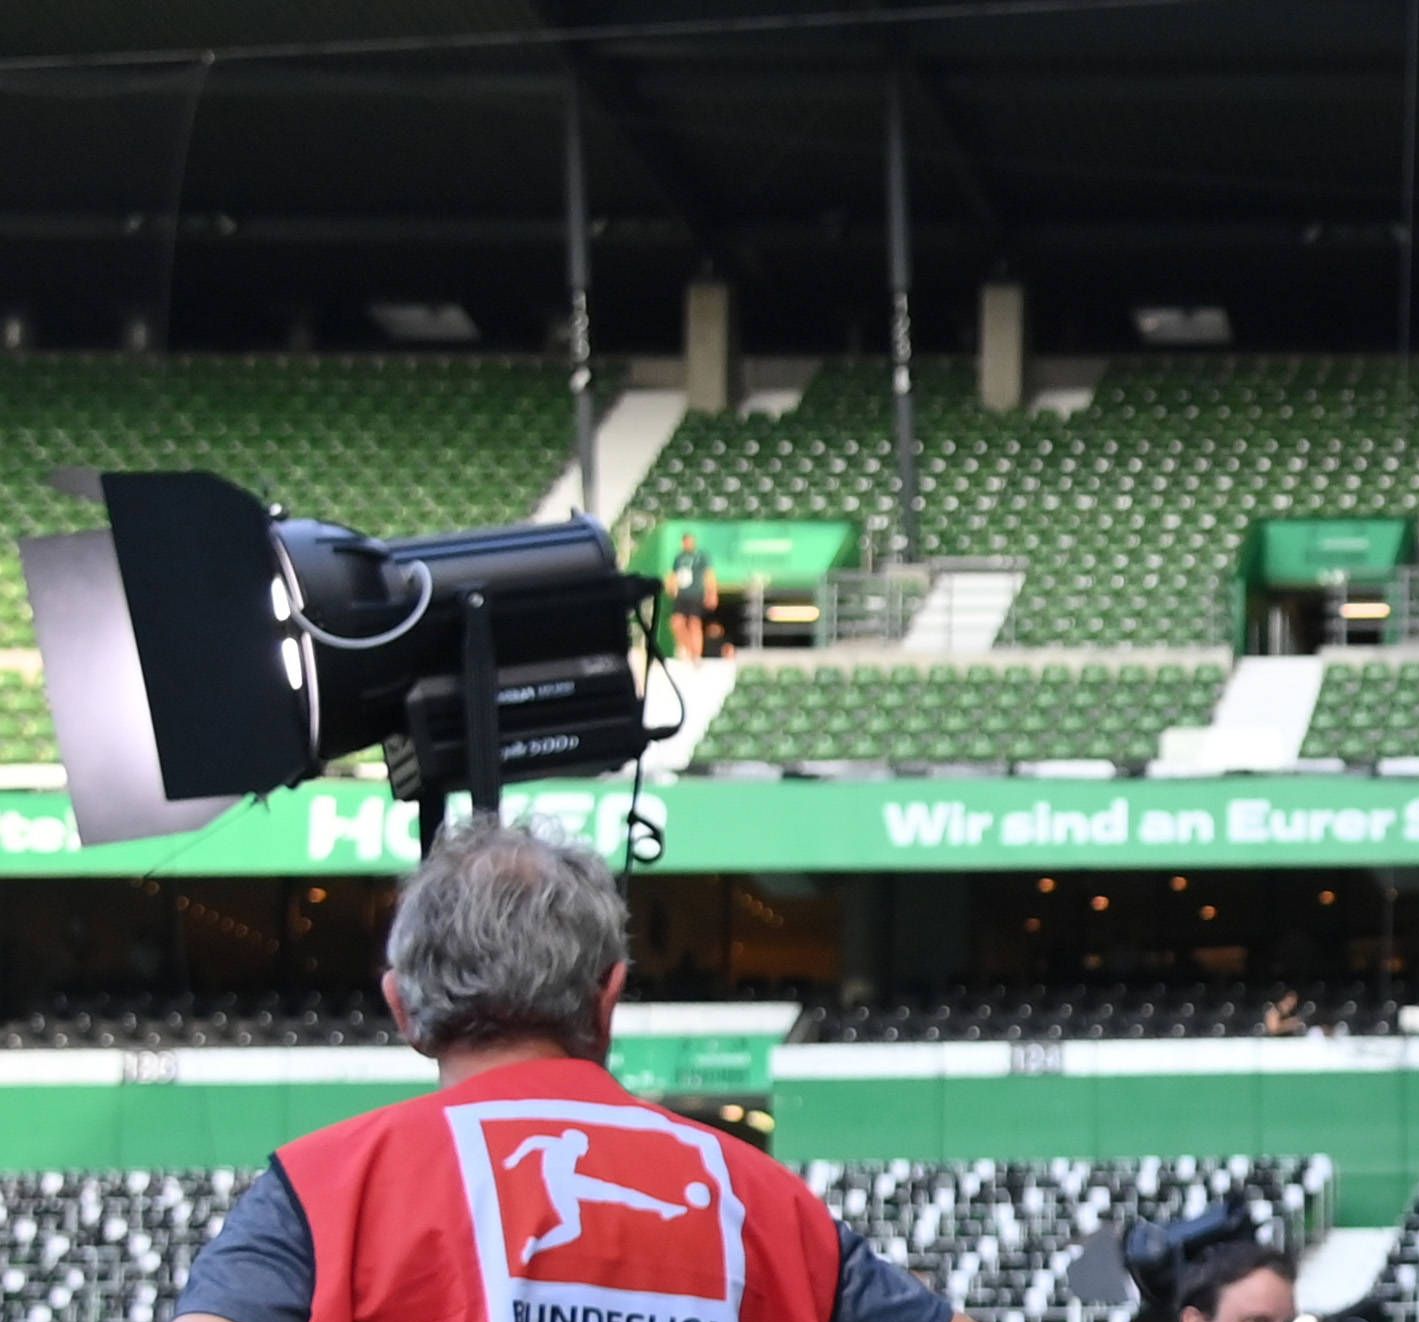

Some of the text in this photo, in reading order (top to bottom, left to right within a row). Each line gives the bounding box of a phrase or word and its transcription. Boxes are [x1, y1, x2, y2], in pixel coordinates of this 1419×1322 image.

[884, 802, 992, 846] Wir
[1000, 799, 1129, 846] sind
[1140, 811, 1214, 844] an
[1226, 798, 1396, 844] Eurer
